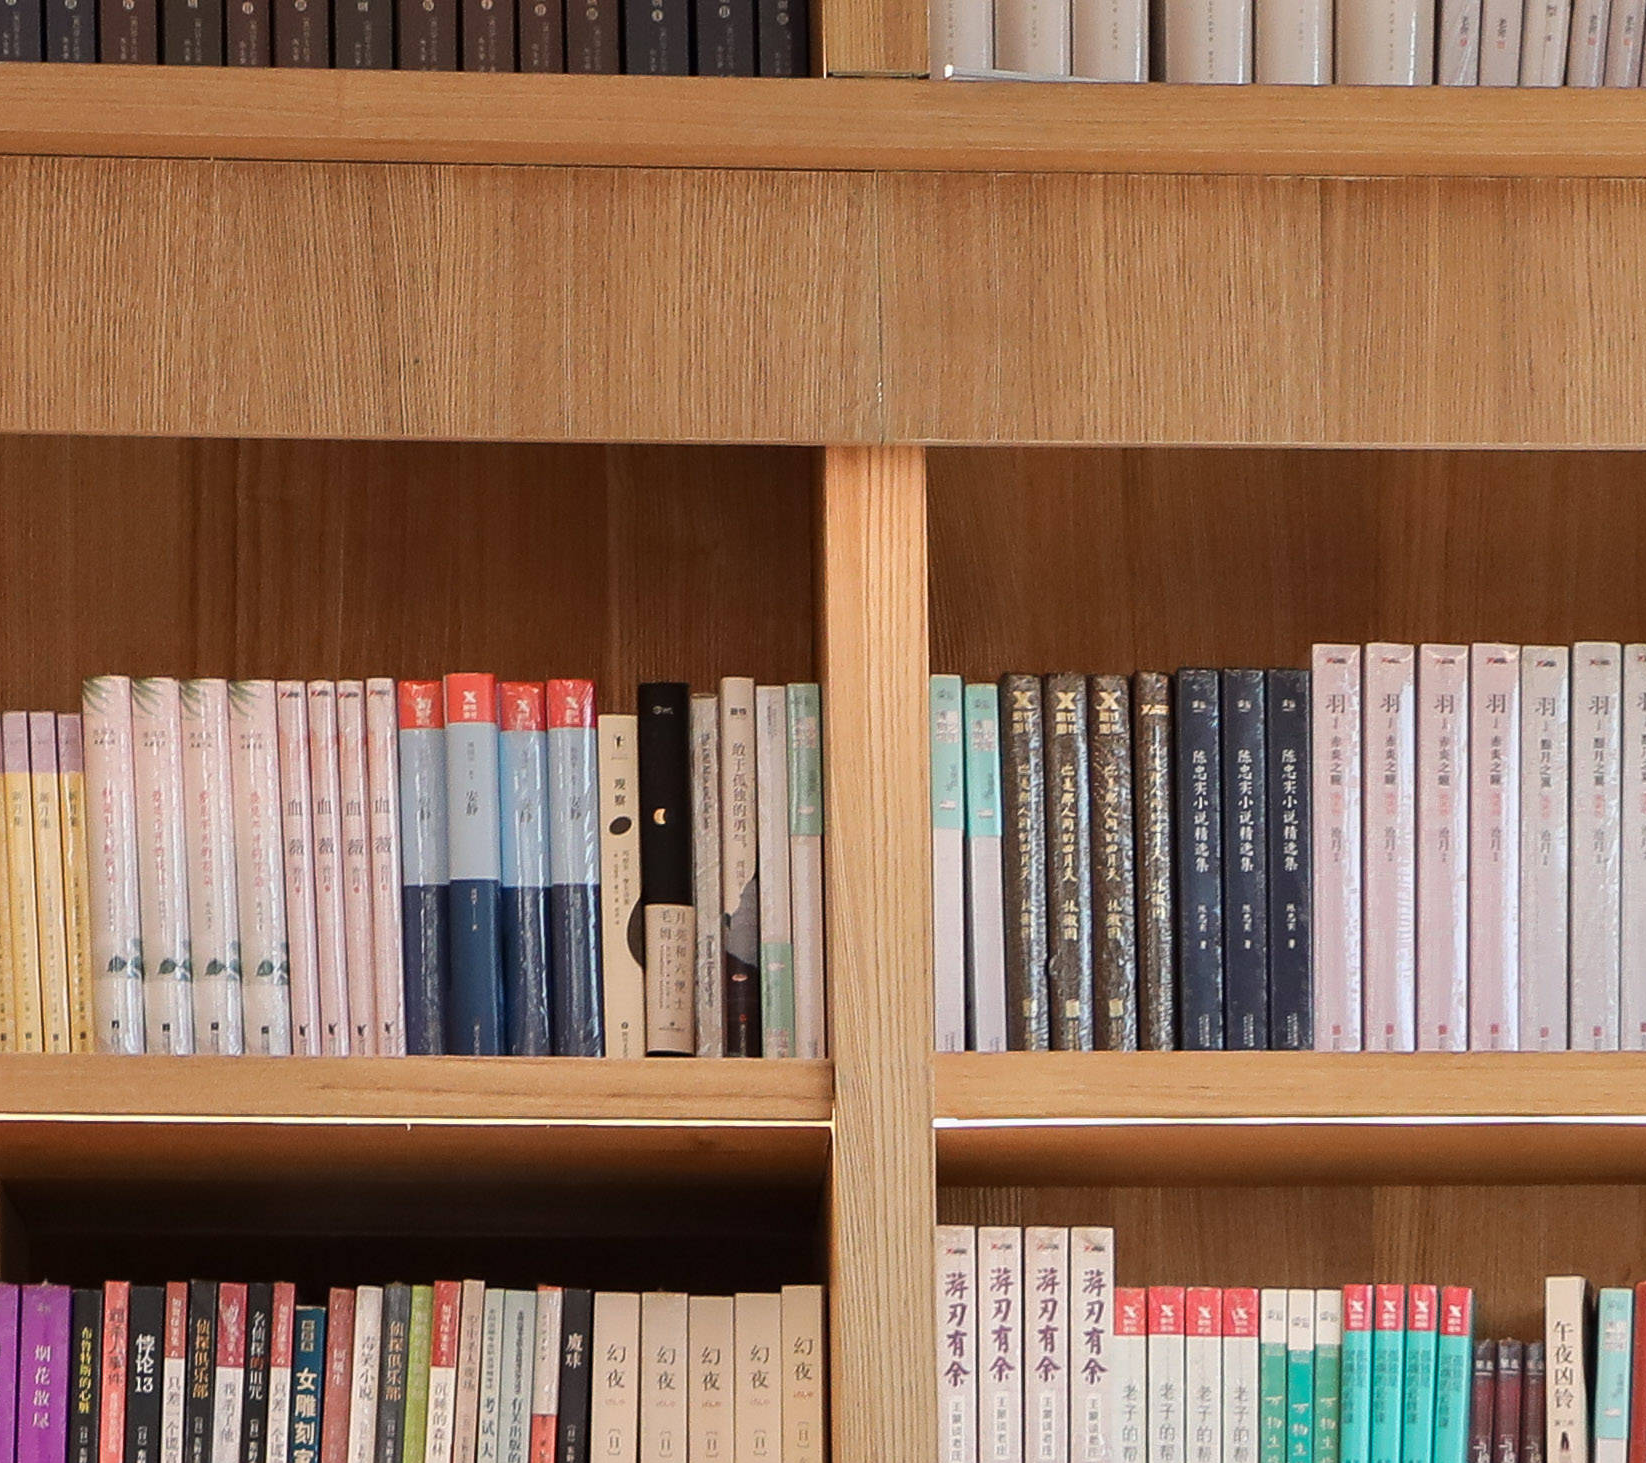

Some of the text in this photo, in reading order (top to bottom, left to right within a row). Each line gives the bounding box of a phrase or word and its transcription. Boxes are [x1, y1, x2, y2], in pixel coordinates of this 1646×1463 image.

[1192, 749, 1210, 873] 陈忠实小说精选集
[1237, 749, 1255, 873] 陈忠实小说精选集
[1281, 749, 1299, 873] 陈忠实小说精选集
[134, 1333, 155, 1394] 悖论13
[193, 1317, 211, 1400] 侦探俱乐部
[249, 1310, 266, 1400] 名侦探的诅咒
[385, 1321, 406, 1401] 侦探俱乐部
[565, 1332, 583, 1370] 魔球
[606, 1343, 628, 1390] 幻夜
[701, 1346, 722, 1391] 幻夜
[750, 1344, 770, 1390] 幻夜
[793, 1336, 814, 1382] 幻夜
[944, 1272, 971, 1387] 游刃有余
[989, 1266, 1015, 1384] 游刃有余
[1034, 1267, 1062, 1384] 游刃有余
[1080, 1268, 1109, 1385] 游刃有余
[1554, 1320, 1574, 1410] 午夜凶铃
[78, 1326, 93, 1414] 布鲁特斯的心脏
[432, 1382, 450, 1457] 沉睡的森林
